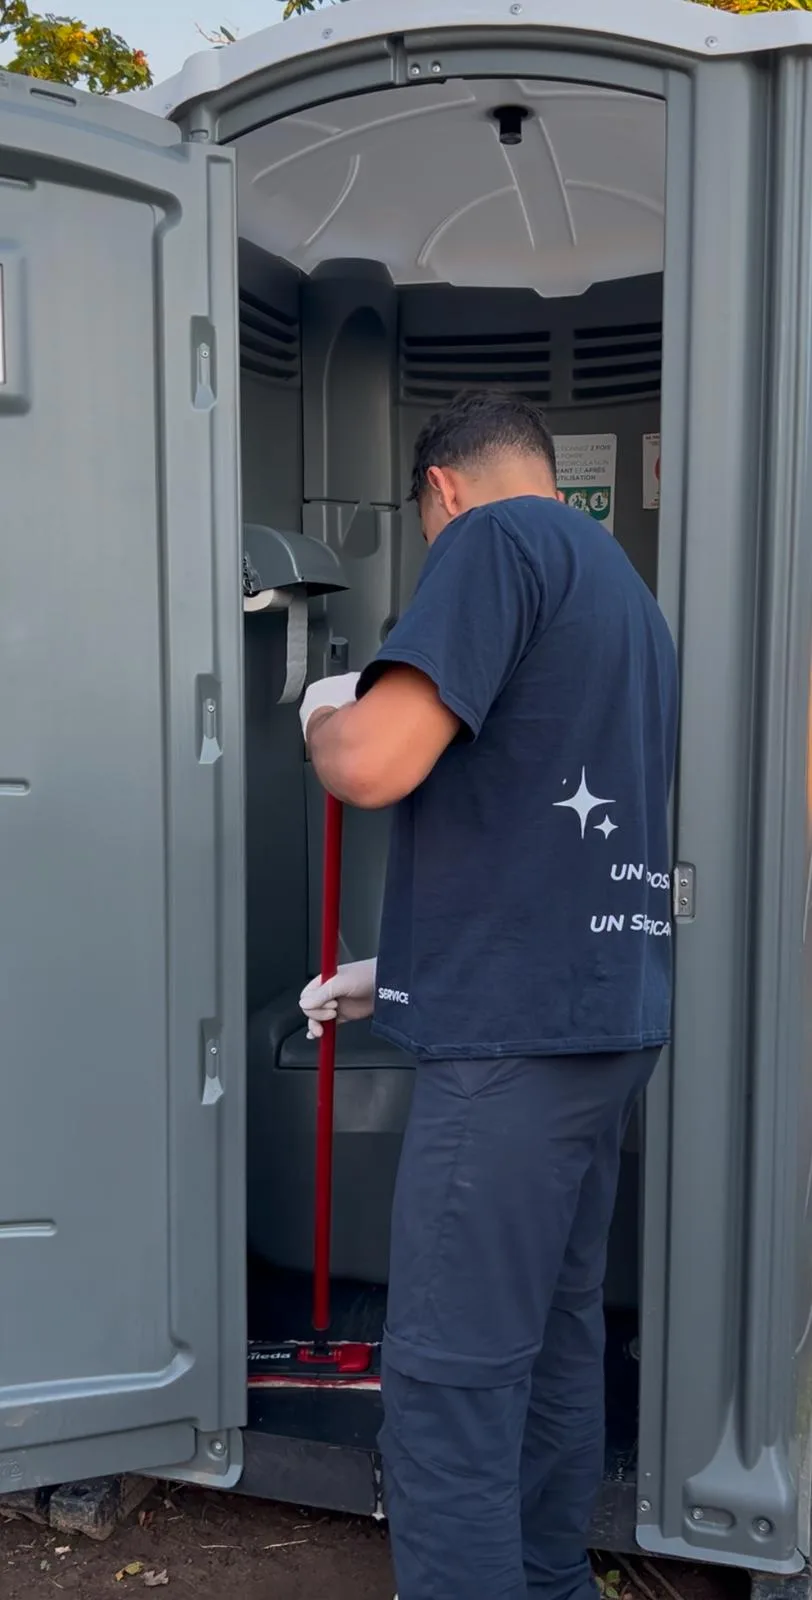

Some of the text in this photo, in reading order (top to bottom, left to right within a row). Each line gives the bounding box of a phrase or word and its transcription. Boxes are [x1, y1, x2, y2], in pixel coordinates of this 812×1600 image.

[610, 863, 644, 881] UN
[590, 914, 625, 933] UN
[378, 987, 409, 1005] SERVICE
[248, 1351, 292, 1360] ileda
